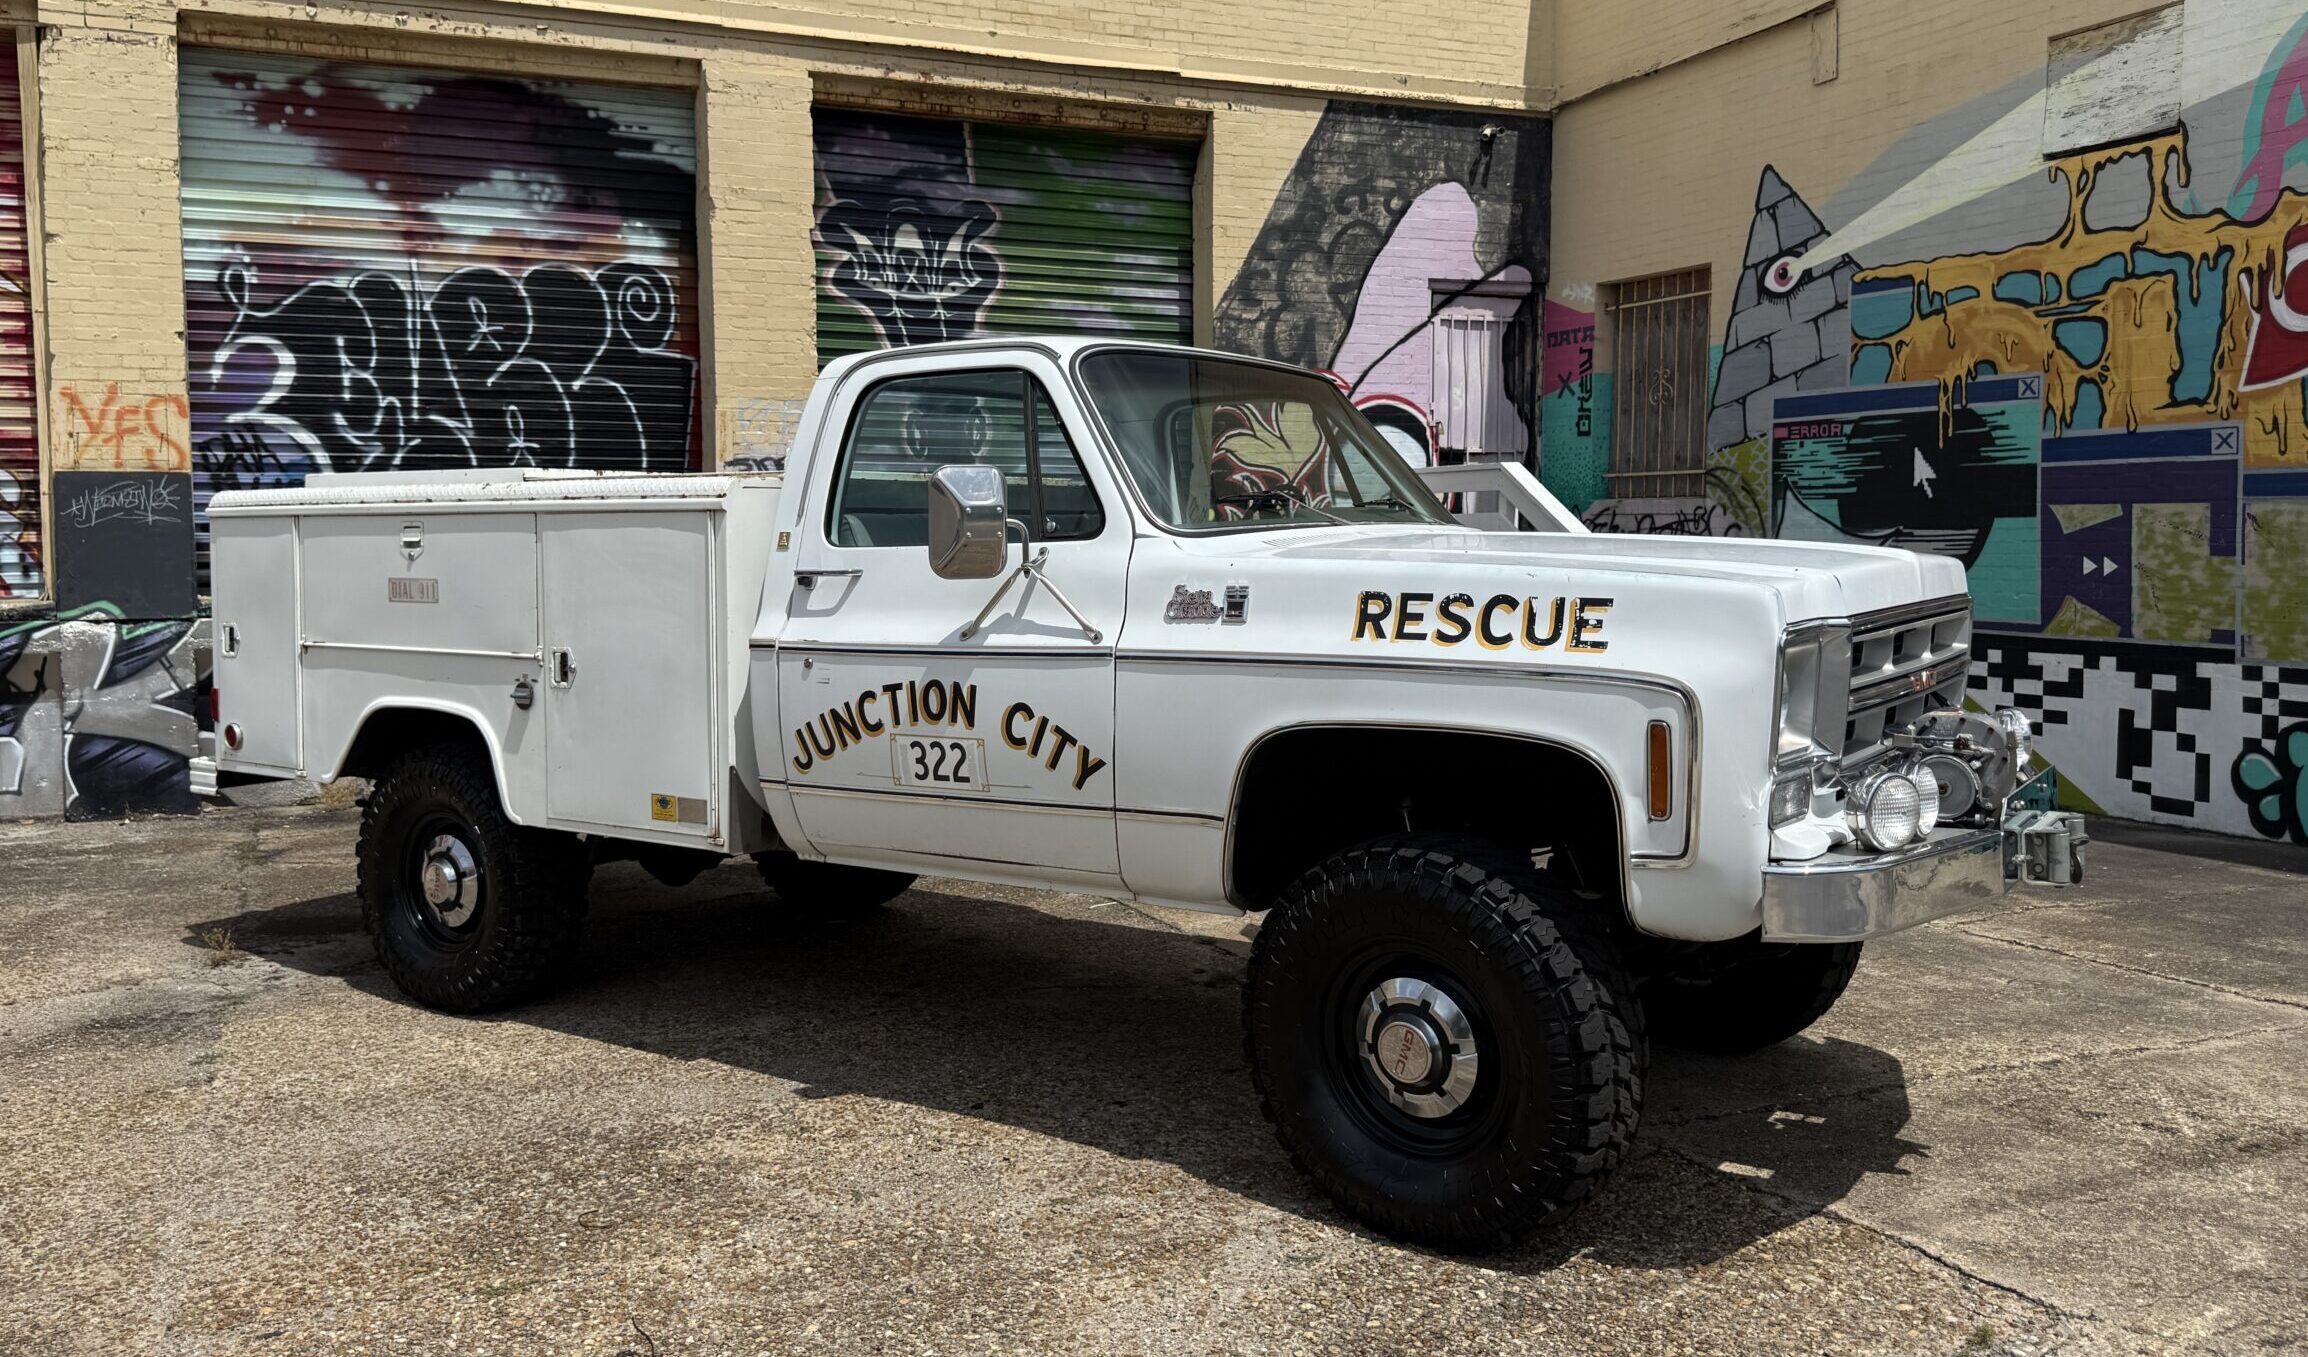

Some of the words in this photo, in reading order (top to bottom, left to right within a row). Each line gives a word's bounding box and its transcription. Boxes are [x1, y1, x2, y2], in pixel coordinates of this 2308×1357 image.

[1790, 423, 1842, 439] ERROR
[391, 581, 415, 600] DIAL
[418, 582, 436, 600] 911
[1351, 590, 1614, 653] RESCUE
[792, 679, 977, 775] JUNCTION
[1001, 701, 1107, 791] CITY
[910, 740, 971, 783] 322
[1395, 1028, 1414, 1076] GMC
